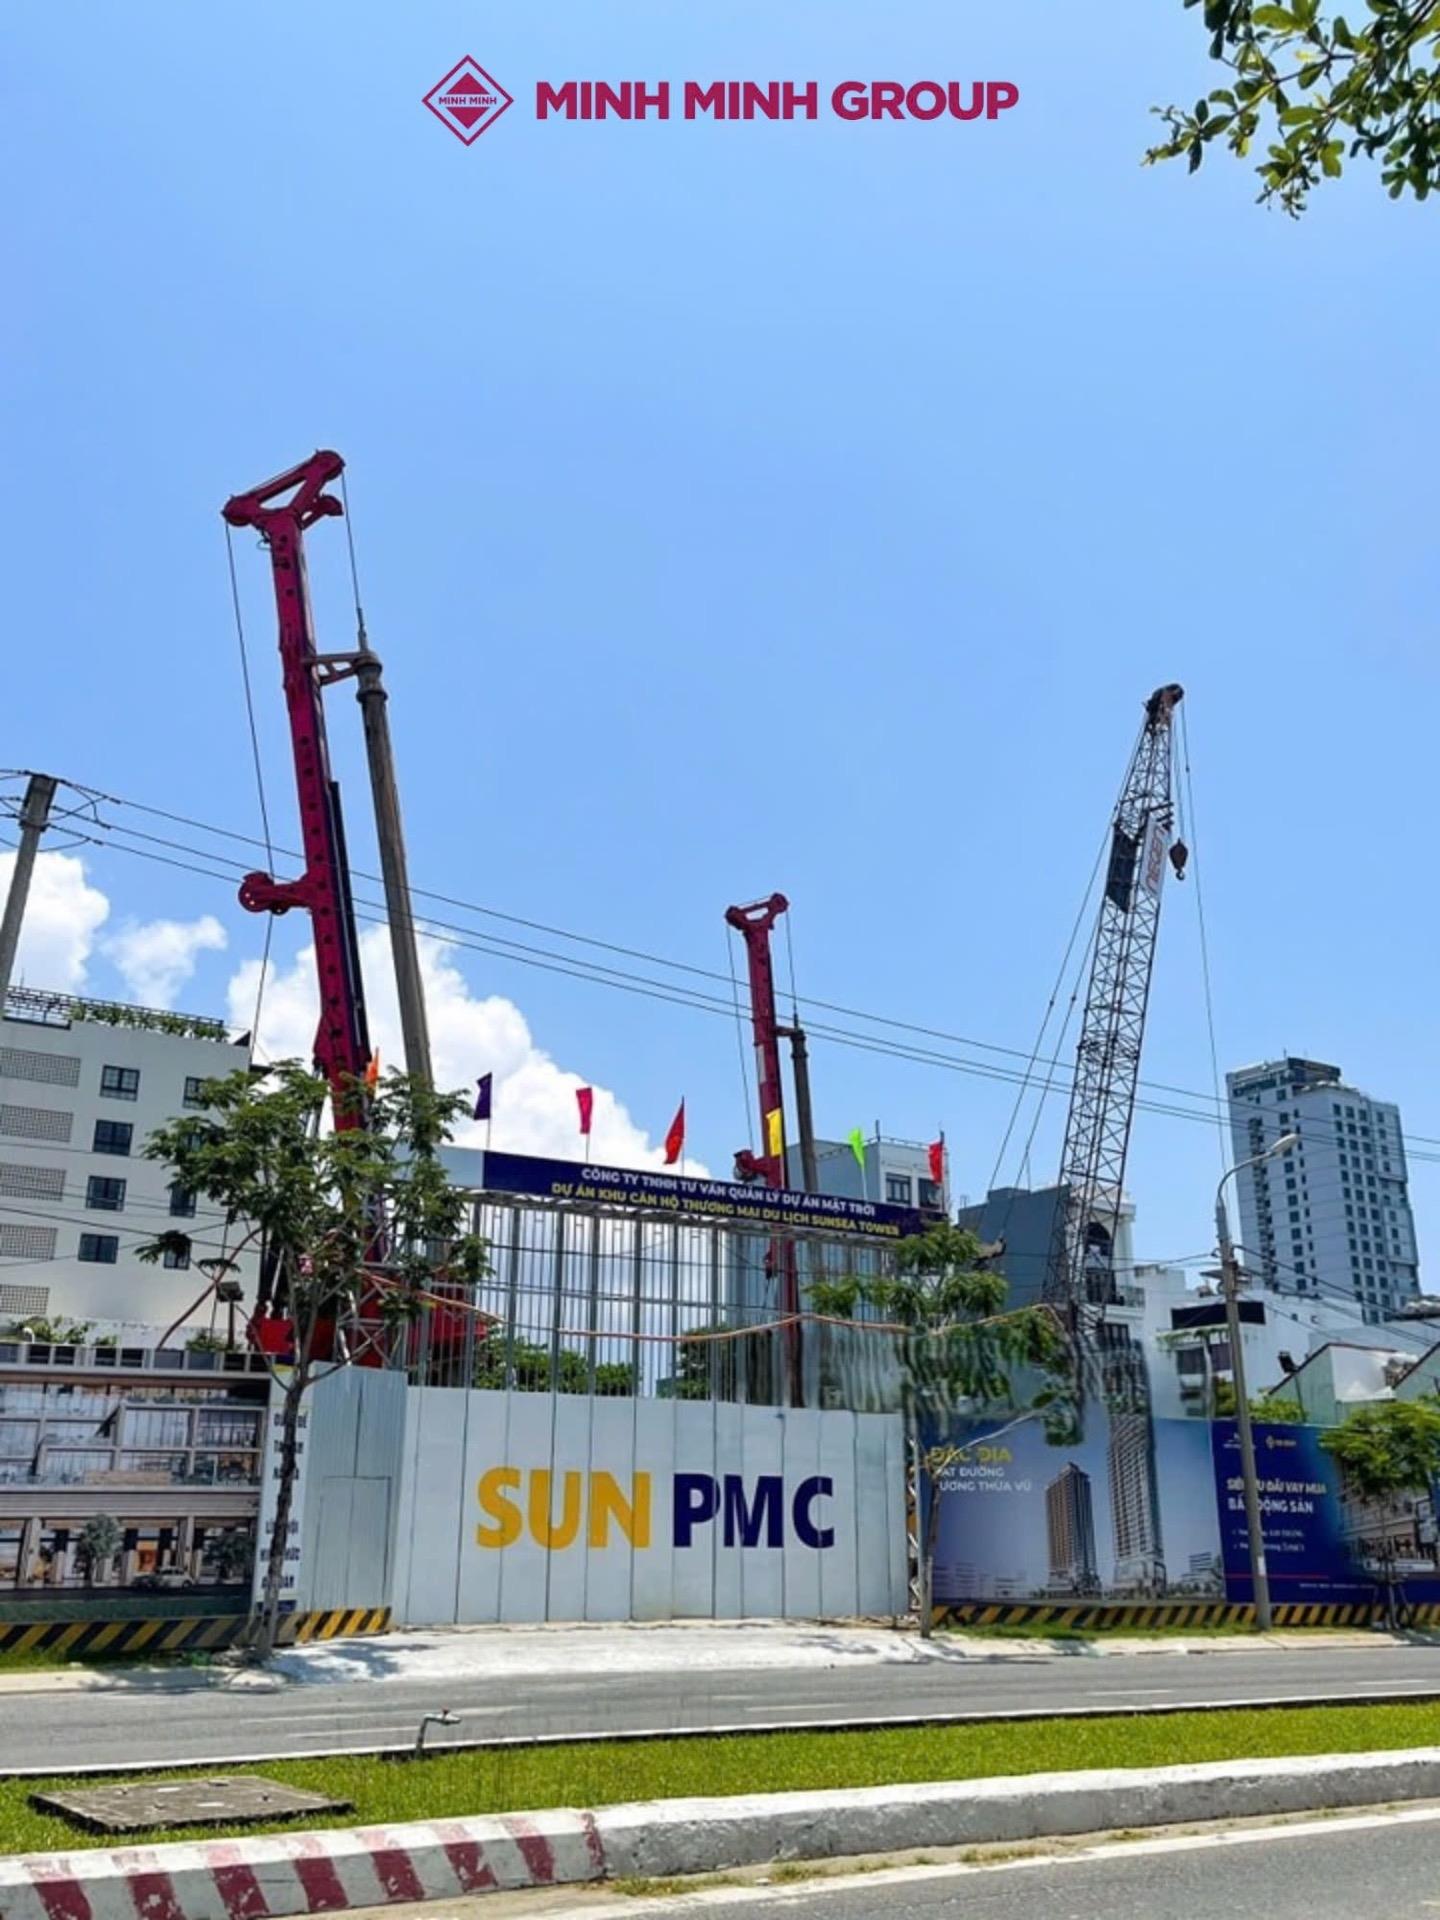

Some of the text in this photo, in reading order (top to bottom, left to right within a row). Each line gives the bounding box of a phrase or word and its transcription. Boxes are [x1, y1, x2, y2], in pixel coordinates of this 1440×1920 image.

[581, 1167, 621, 1182] CÔNG
[621, 1173, 639, 1186] TY
[641, 1176, 677, 1190] TNHH
[680, 1180, 697, 1193] TƯ
[575, 1183, 595, 1198] ÁN
[598, 1188, 626, 1201] KHU
[763, 1208, 780, 1220] DU
[783, 1211, 809, 1225] LỊCH
[811, 1215, 857, 1230] SUNSEA
[858, 1221, 899, 1236] TOWER
[939, 1480, 977, 1491] ƯƠNG
[1285, 1481, 1304, 1494] VAY
[475, 1466, 835, 1551] SUN PMC
